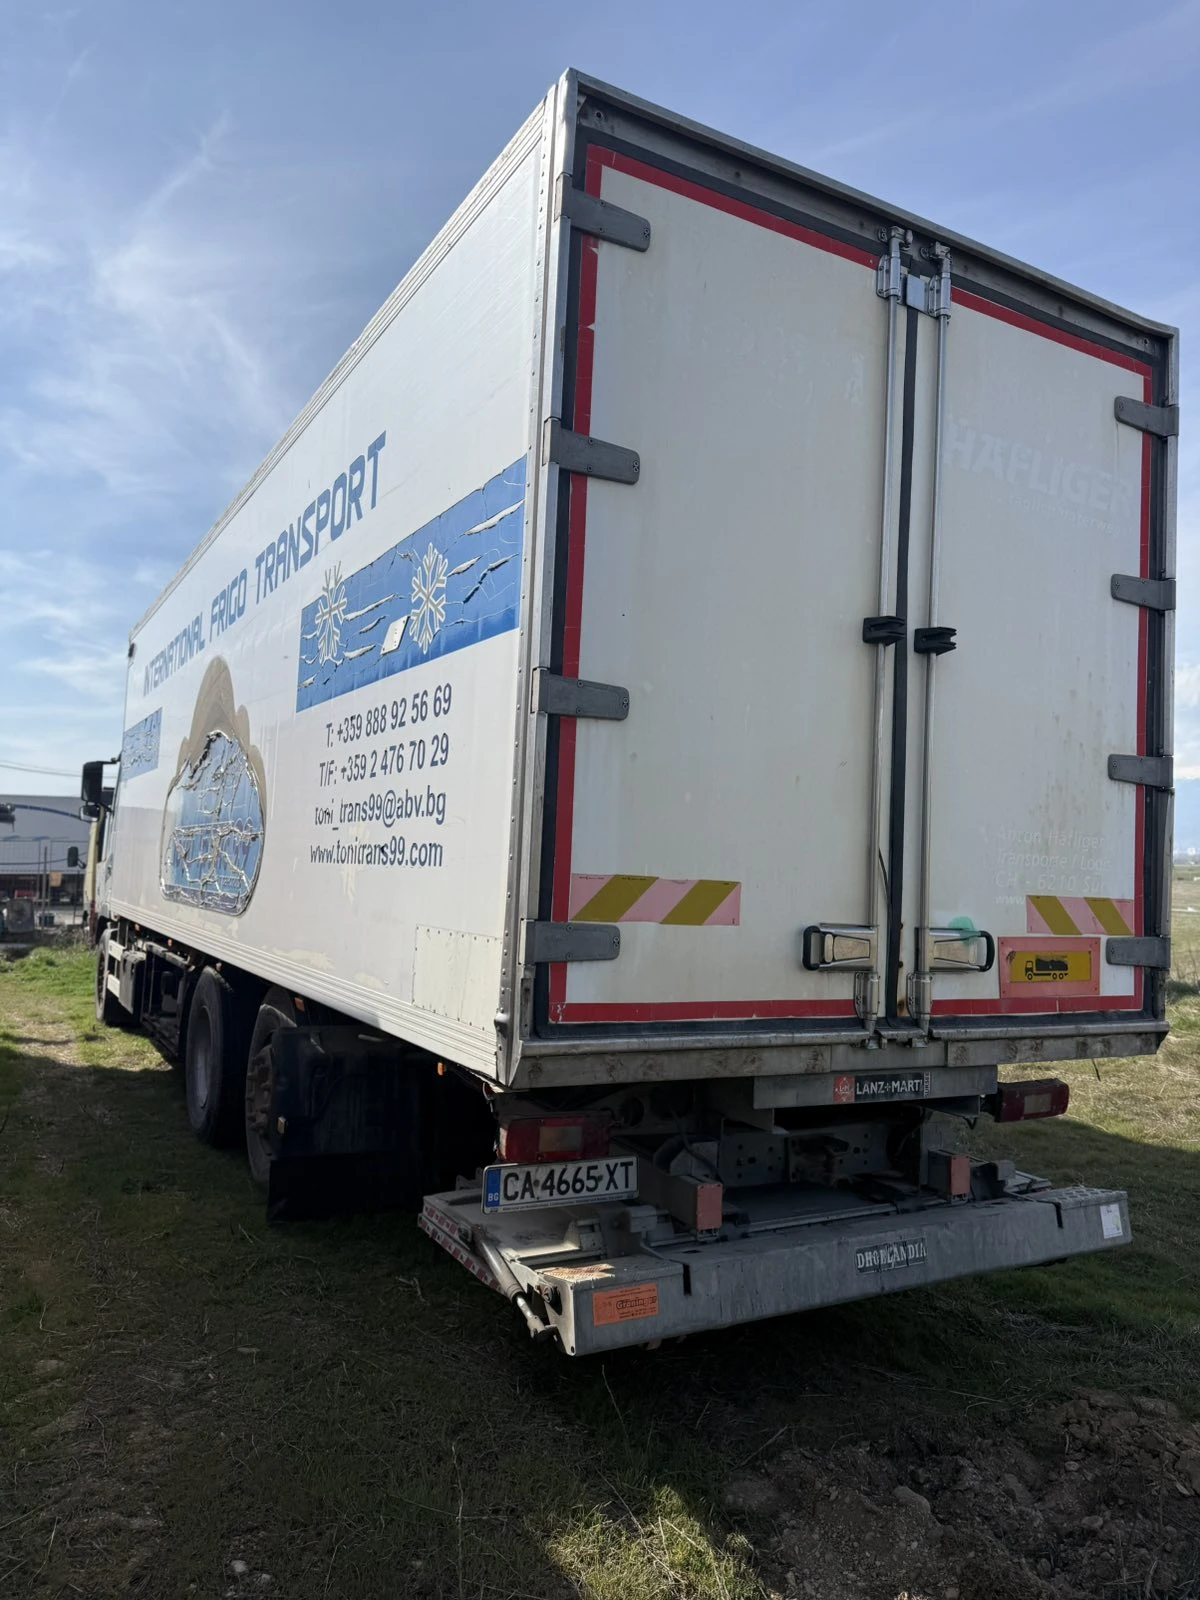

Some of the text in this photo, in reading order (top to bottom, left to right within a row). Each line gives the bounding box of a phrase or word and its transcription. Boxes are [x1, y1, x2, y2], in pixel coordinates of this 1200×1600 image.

[209, 568, 247, 643] FRIGO
[255, 430, 386, 605] TRANSPORT
[326, 682, 452, 748] T: +359 888 92 56 69
[319, 732, 449, 787] T/F: +359 2 476 70 29
[314, 785, 446, 831] toni_trans99@abv.bg
[310, 835, 443, 867] www.tonitrans99.com
[488, 1161, 633, 1202] BG CA 4665 XT
